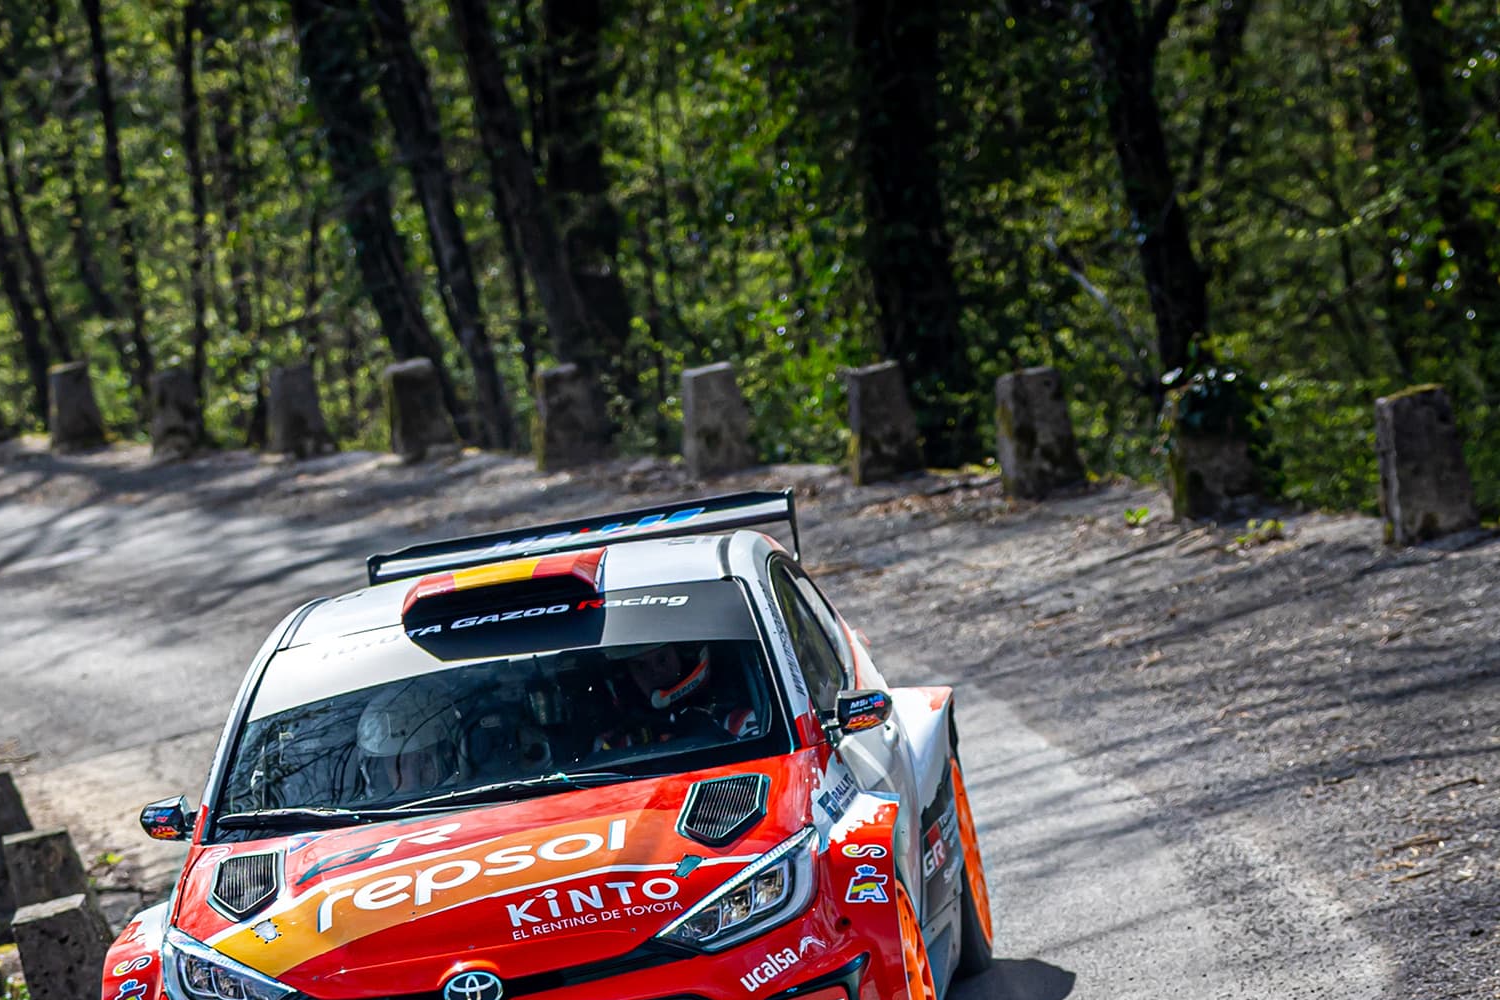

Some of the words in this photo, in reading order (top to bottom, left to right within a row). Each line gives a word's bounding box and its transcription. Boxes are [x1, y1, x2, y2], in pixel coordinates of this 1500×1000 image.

[450, 604, 570, 630] GAZOO
[576, 595, 689, 611] Racing
[317, 820, 626, 933] repsol
[924, 842, 945, 878] GR
[512, 929, 530, 941] EL
[532, 914, 598, 936] RENTING
[600, 909, 622, 922] DE
[624, 900, 683, 919] TOYOTA
[740, 948, 799, 992] ucalsa
